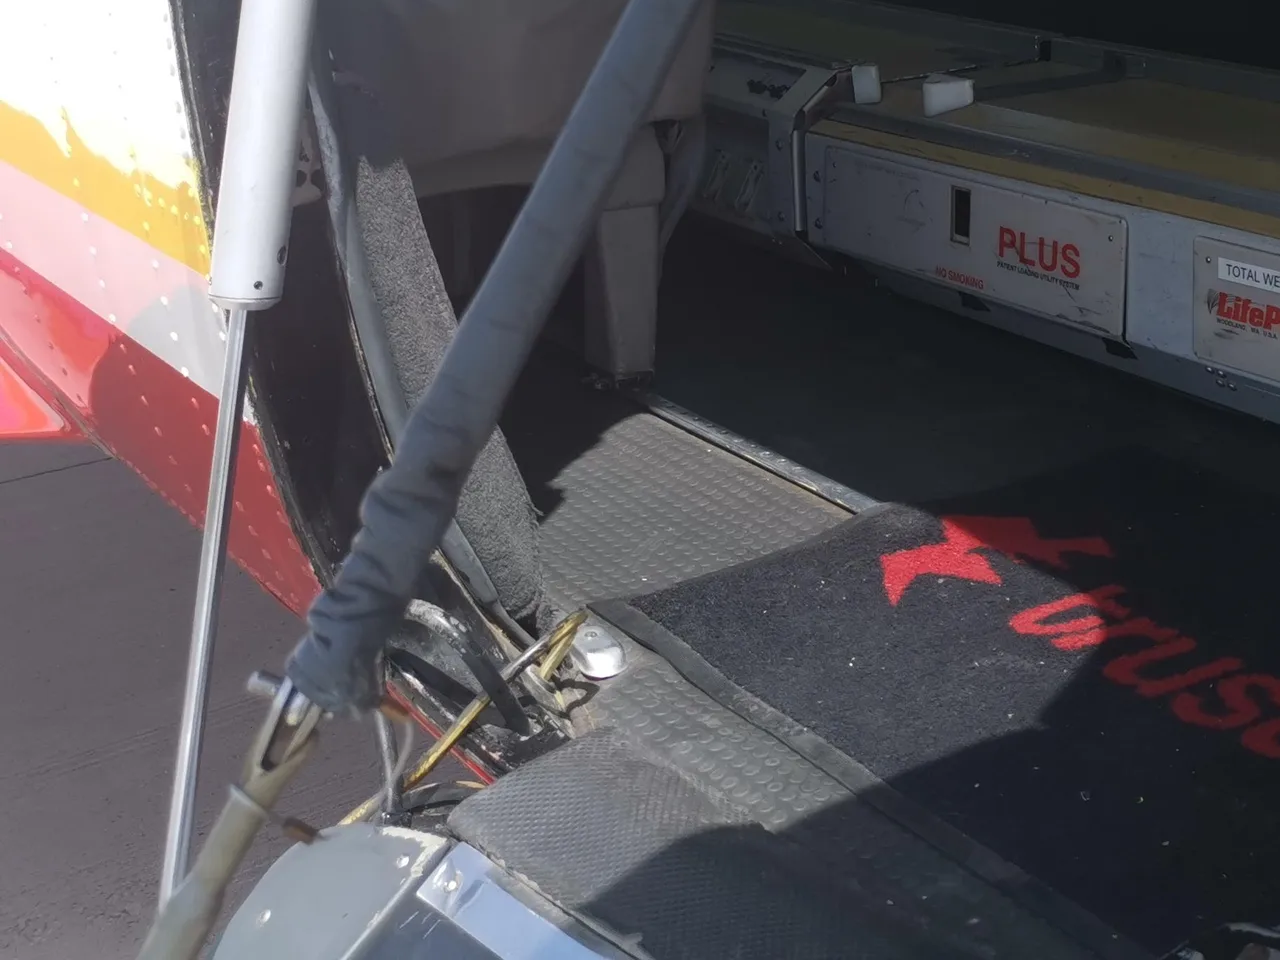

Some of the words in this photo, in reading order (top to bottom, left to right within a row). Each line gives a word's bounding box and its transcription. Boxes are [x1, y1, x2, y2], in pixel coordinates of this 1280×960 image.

[998, 226, 1081, 279] PLUS
[935, 265, 947, 278] NO
[948, 270, 984, 290] SMOKING
[1226, 263, 1260, 284] TOTAL
